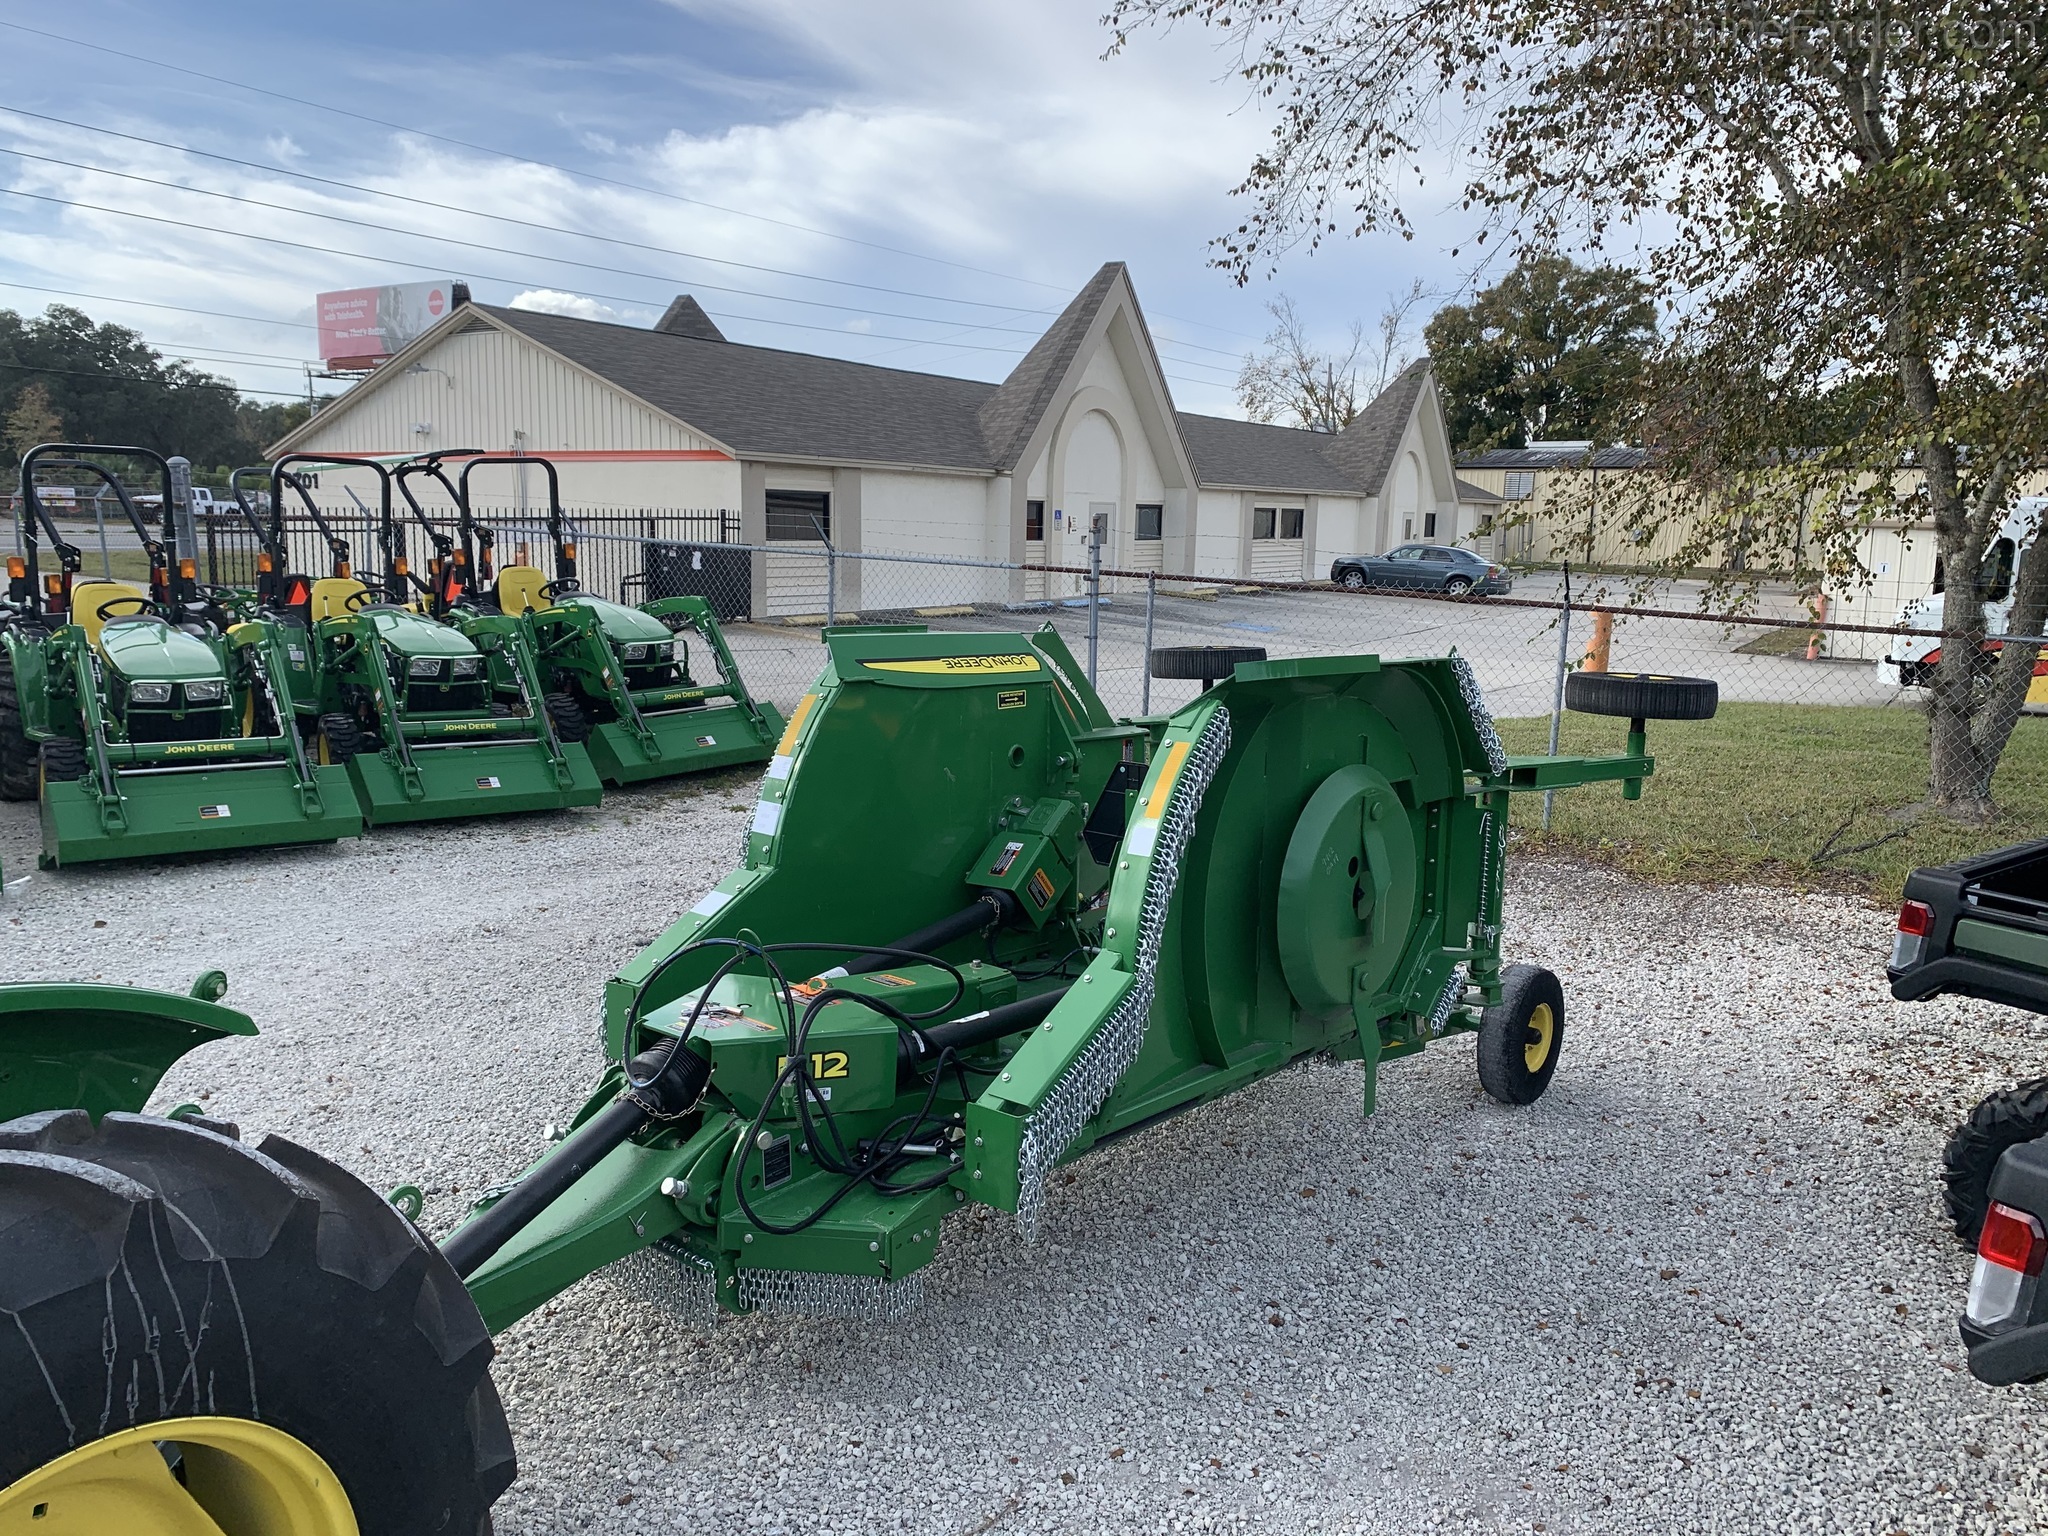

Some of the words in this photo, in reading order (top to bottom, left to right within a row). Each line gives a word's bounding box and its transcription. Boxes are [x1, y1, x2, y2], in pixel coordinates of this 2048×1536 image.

[350, 298, 367, 307] advice
[324, 311, 336, 321] with
[942, 657, 992, 668] DEERE
[992, 656, 1028, 667] JOHN
[663, 693, 681, 701] JOHN
[682, 690, 705, 698] DEERE
[468, 722, 497, 730] DEERE
[165, 745, 195, 754] JOHN
[198, 743, 235, 752] DEERE
